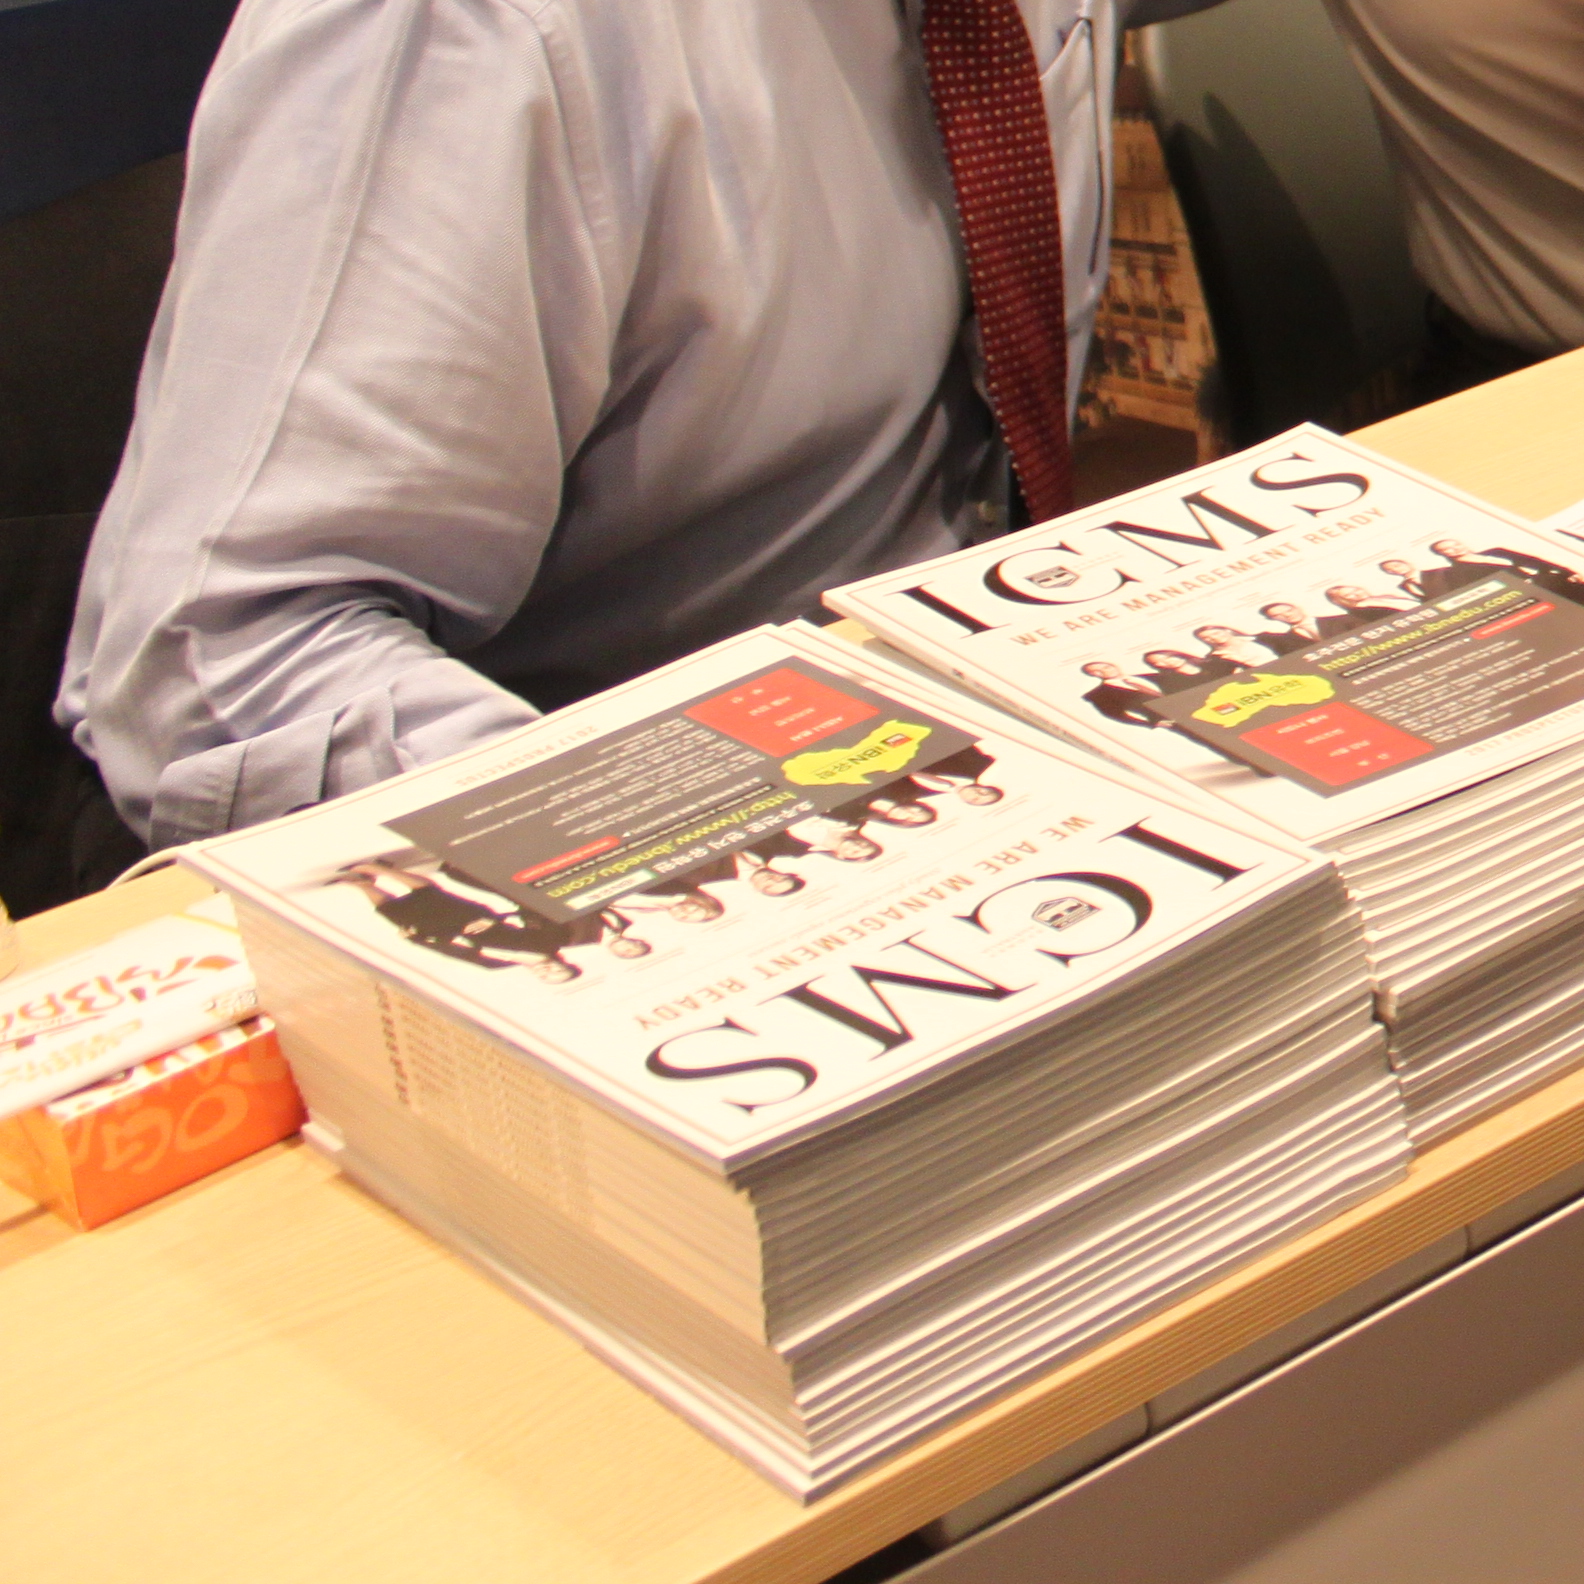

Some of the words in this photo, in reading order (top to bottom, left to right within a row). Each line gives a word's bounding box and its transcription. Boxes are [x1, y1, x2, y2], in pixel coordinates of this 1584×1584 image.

[884, 452, 1371, 638] ICMS
[1010, 624, 1057, 648] WE
[1062, 607, 1117, 634] ARE
[1121, 542, 1301, 613] MANAGEMENT
[1305, 506, 1386, 545] READY
[1318, 590, 1522, 671] http://www.ibnedu.com
[547, 790, 798, 898] http://www.ibnedu.com
[976, 840, 1038, 875] ARE
[1040, 816, 1094, 843] WE
[645, 816, 1265, 1115] ICMS
[756, 873, 976, 983] MANAGEMENT
[635, 978, 748, 1031] READY
